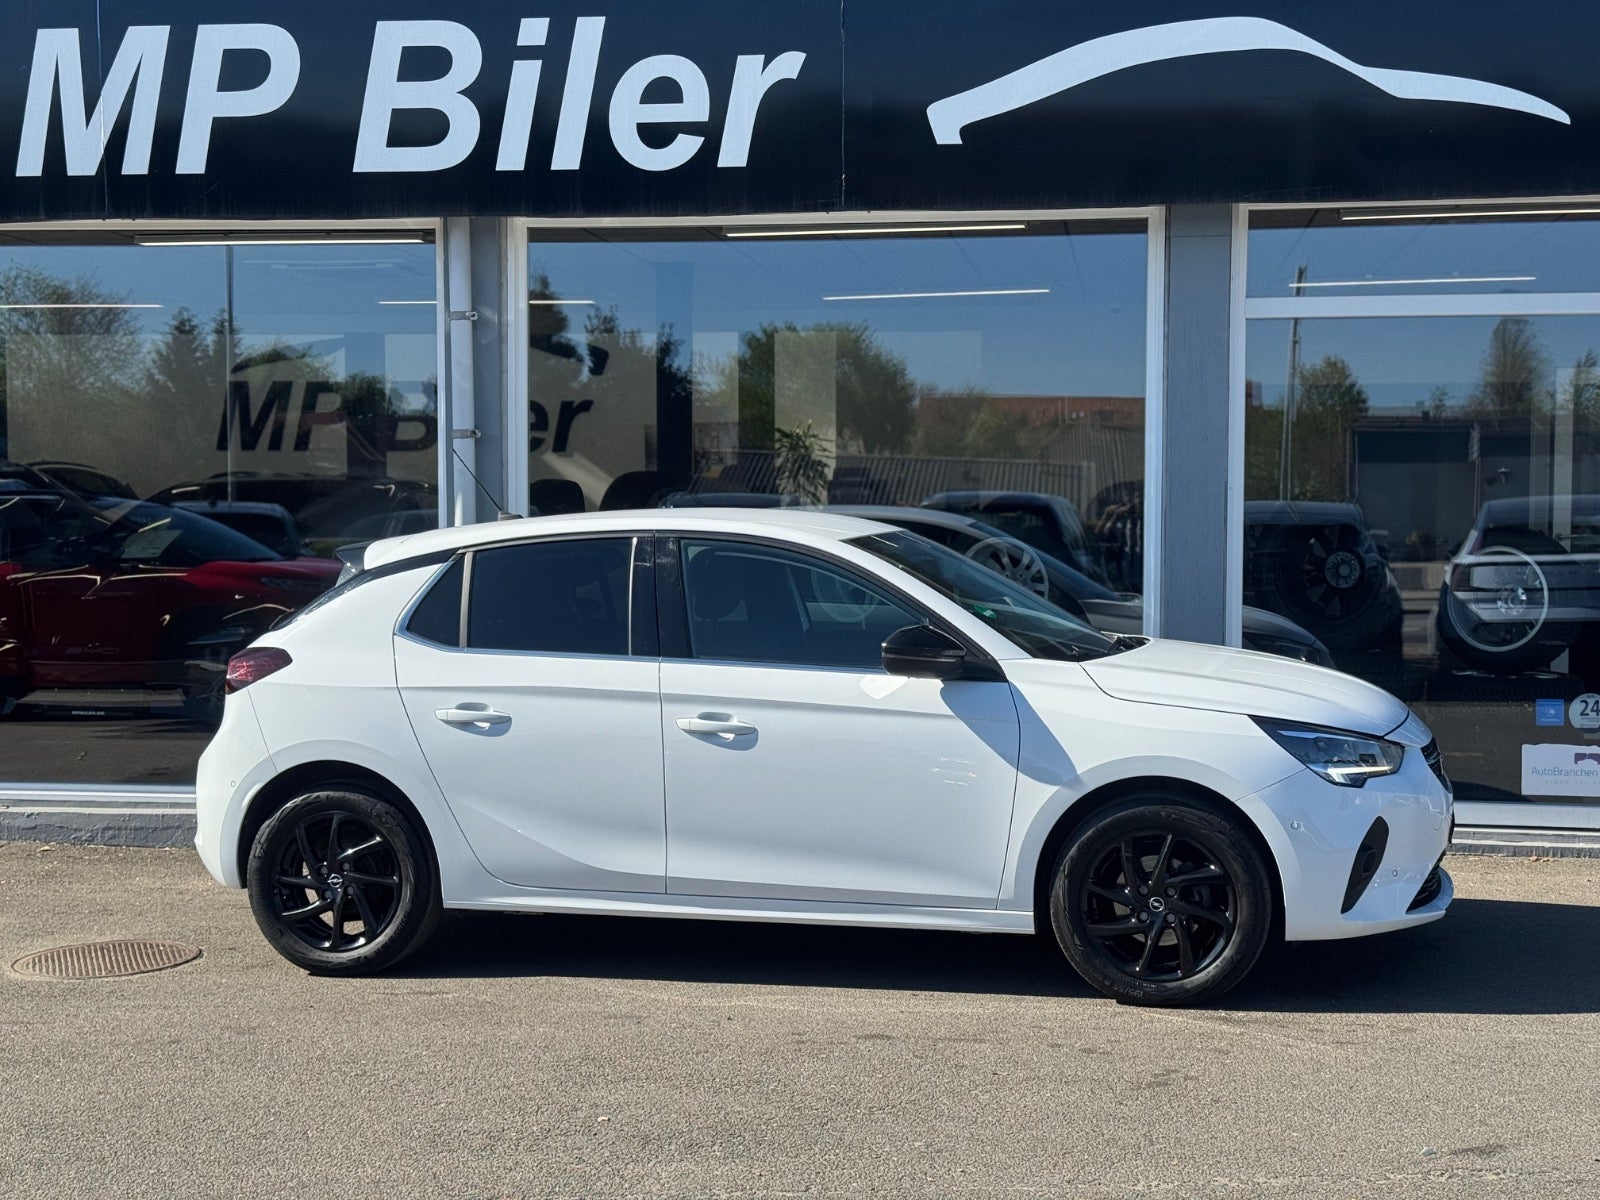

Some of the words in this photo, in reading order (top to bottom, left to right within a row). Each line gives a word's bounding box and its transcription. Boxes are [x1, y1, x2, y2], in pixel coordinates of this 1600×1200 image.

[16, 24, 300, 176] MP
[353, 16, 806, 172] Biler
[1530, 766, 1599, 777] AutoBranchen
